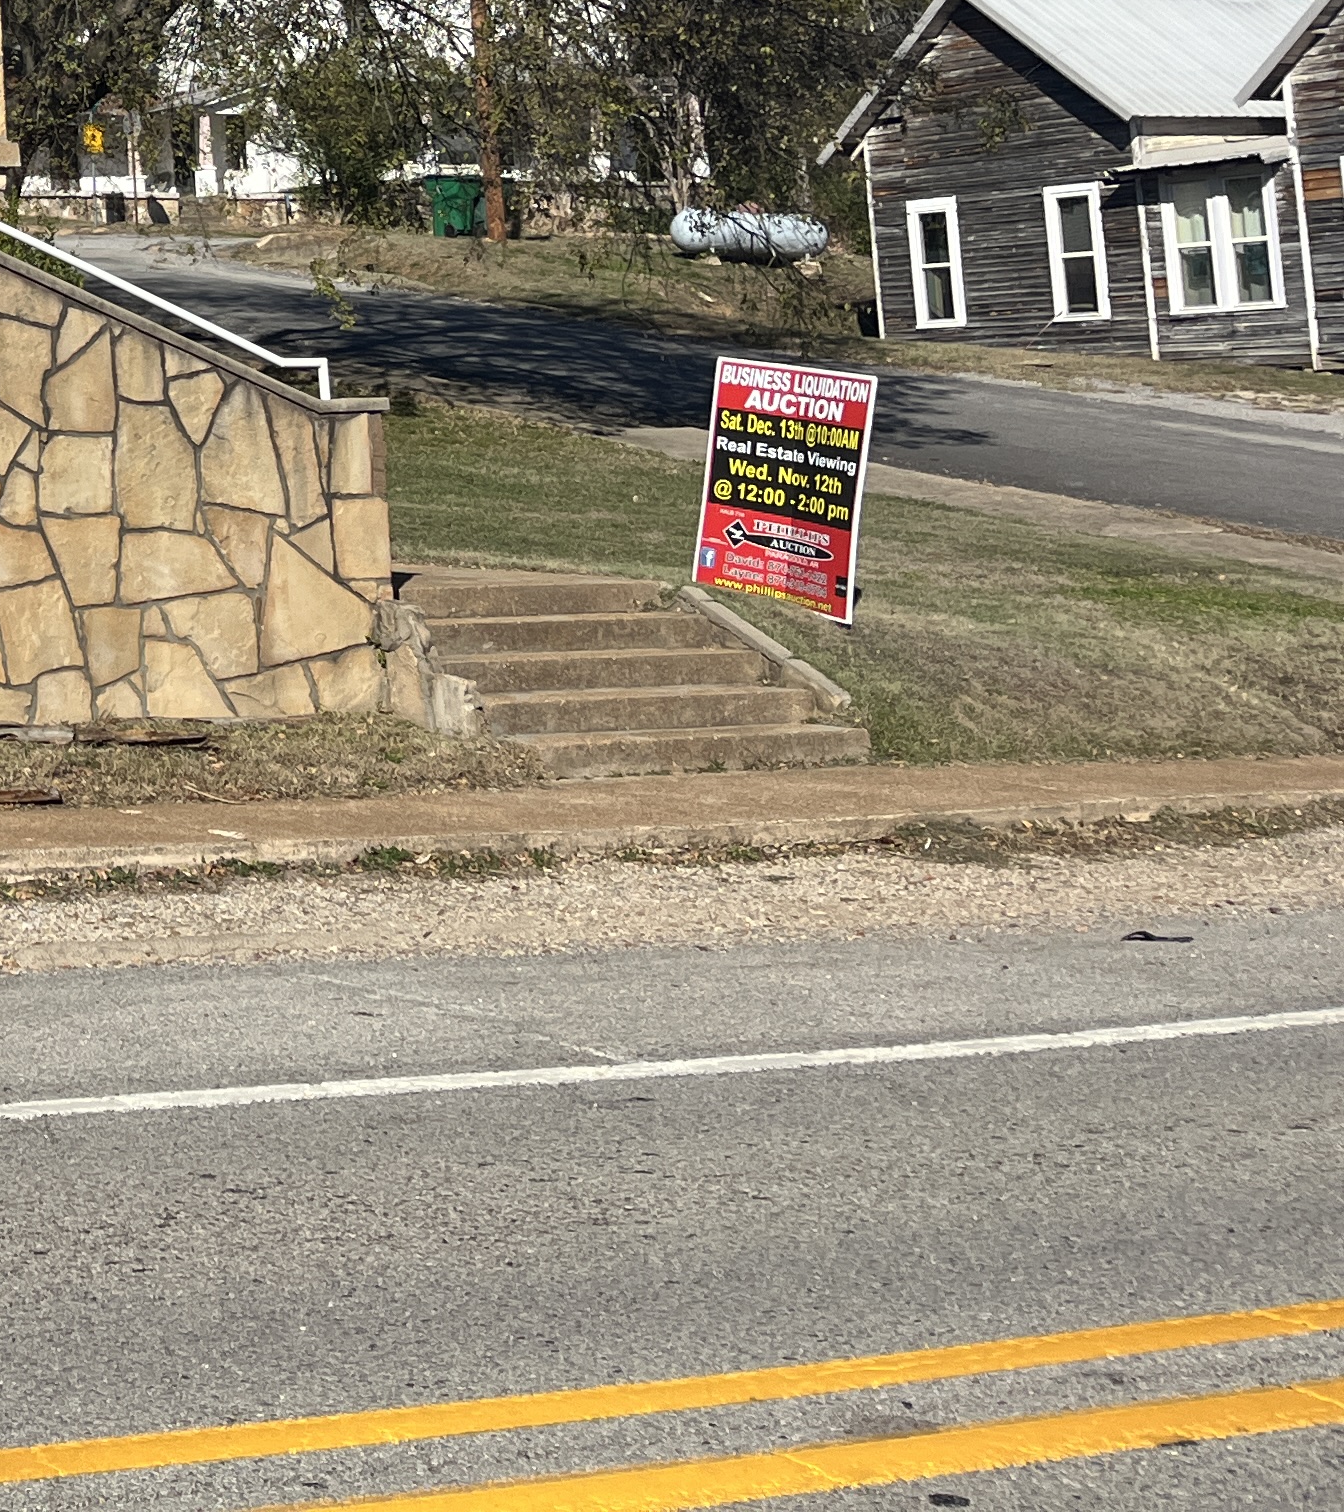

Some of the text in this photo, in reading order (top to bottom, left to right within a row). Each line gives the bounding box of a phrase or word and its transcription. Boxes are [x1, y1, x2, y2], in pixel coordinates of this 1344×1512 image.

[721, 365, 870, 403] BUSINESS LIQUIDATION
[720, 409, 744, 432] Sat.
[747, 413, 776, 437] Dec.
[779, 418, 805, 441] 13th
[744, 389, 845, 423] AUCTION
[716, 435, 857, 476] Real Estate Viewing
[728, 457, 842, 496] Wed. Nov. 12th
[713, 479, 733, 501] @
[737, 482, 786, 507] 12:00
[797, 494, 825, 516] 2:00
[827, 504, 849, 521] pm
[770, 538, 816, 557] AUCTION
